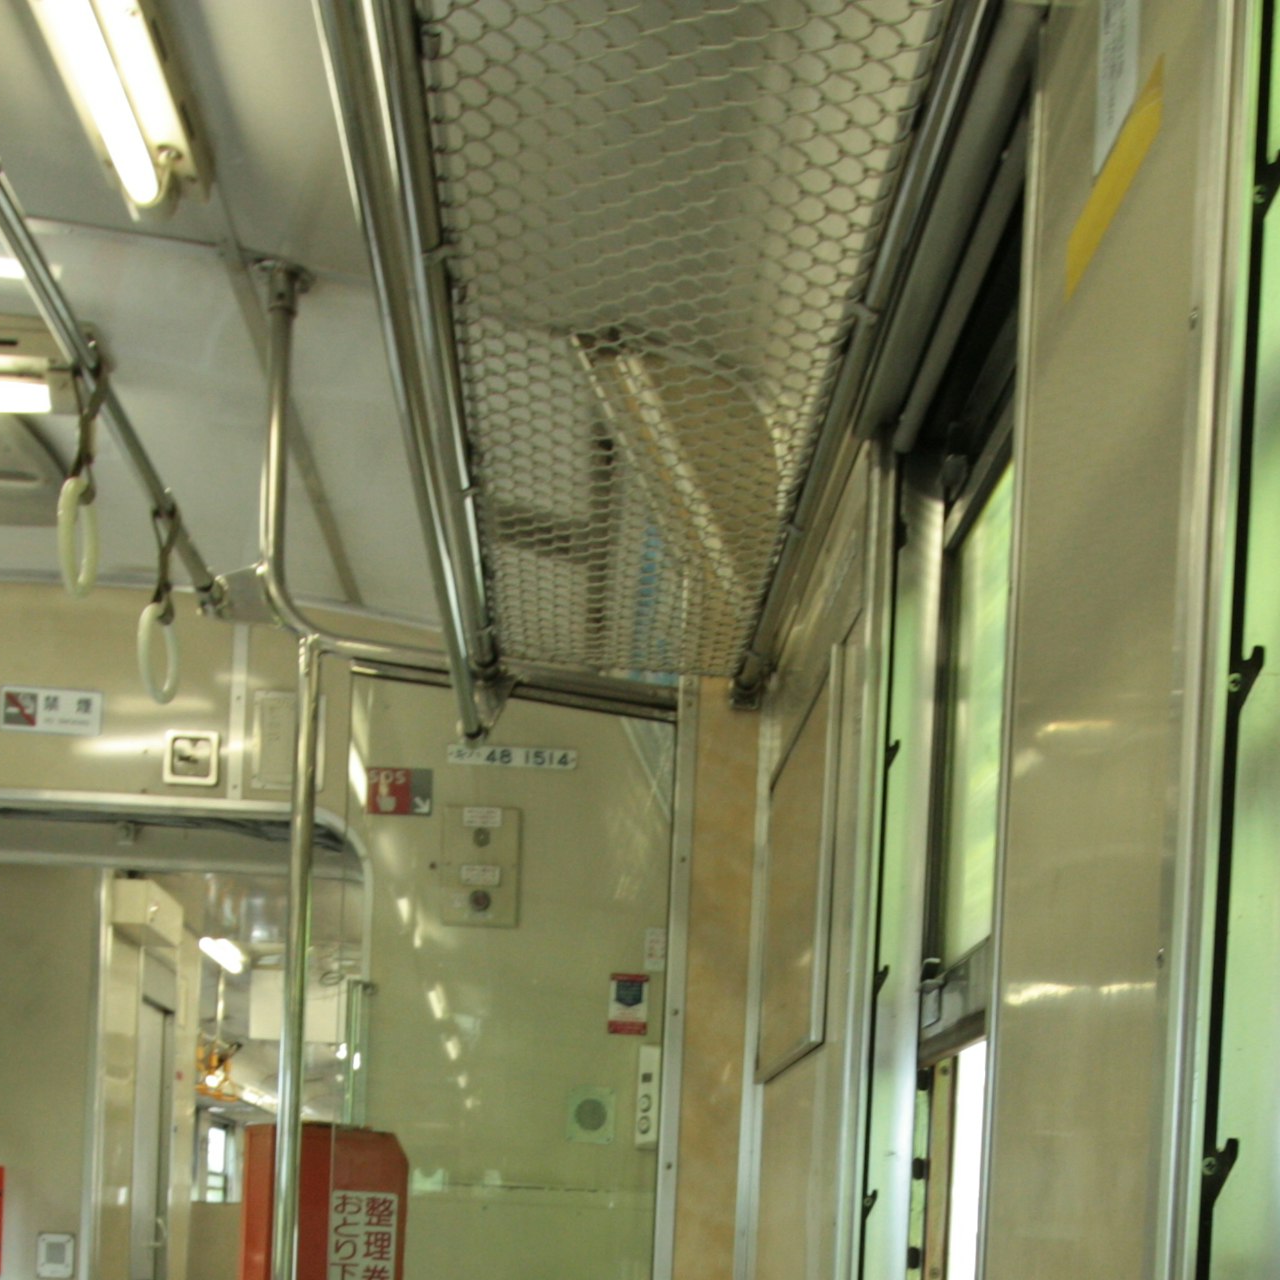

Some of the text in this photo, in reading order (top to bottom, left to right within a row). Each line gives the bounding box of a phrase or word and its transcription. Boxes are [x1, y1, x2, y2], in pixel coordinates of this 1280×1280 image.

[484, 748, 513, 765] 48
[524, 750, 570, 767] 1514
[368, 769, 407, 785] SOS
